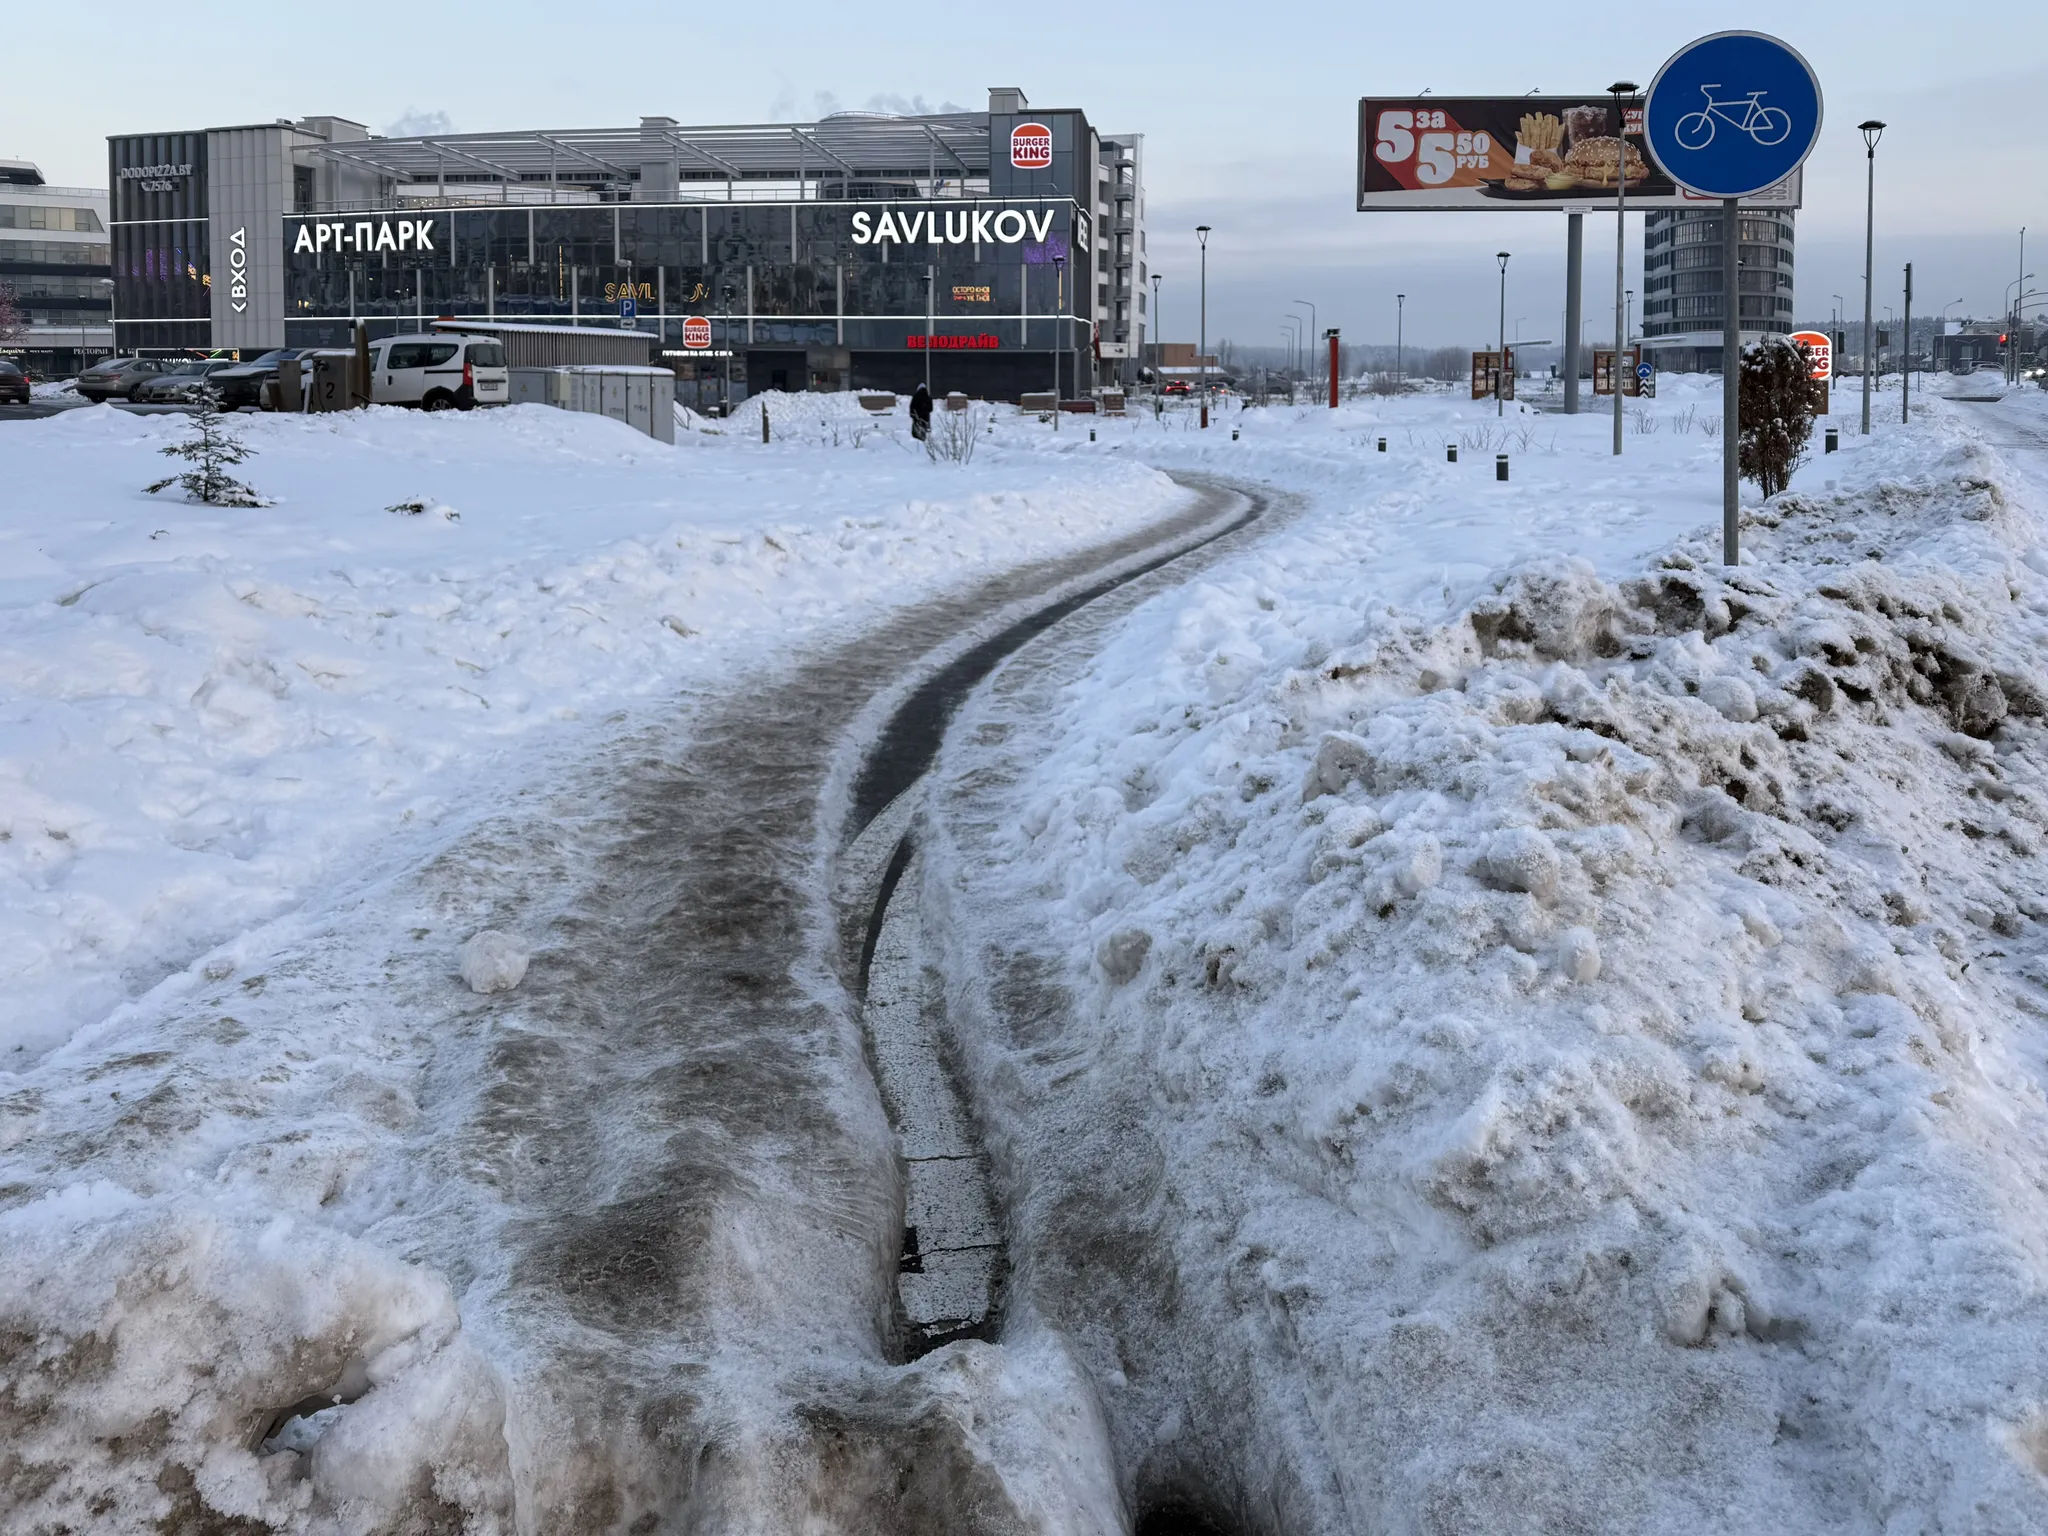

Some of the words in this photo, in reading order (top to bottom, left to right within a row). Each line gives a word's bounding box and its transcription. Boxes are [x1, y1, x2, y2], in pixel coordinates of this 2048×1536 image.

[1013, 138, 1050, 146] BURGER
[1376, 111, 1415, 162] 5
[1013, 147, 1050, 159] KING
[1417, 133, 1456, 184] 5
[1456, 133, 1490, 154] 50
[1457, 155, 1489, 168] РУБ
[121, 163, 193, 179] DODOPIZZA.BY
[851, 209, 1055, 245] SAVLUKOV
[293, 219, 434, 254] АРТ-ПАРК
[230, 226, 247, 299] ВХОД
[684, 333, 709, 341] KING
[907, 332, 999, 349] ВЕЛОДРАЙВ
[326, 382, 335, 399] 2
